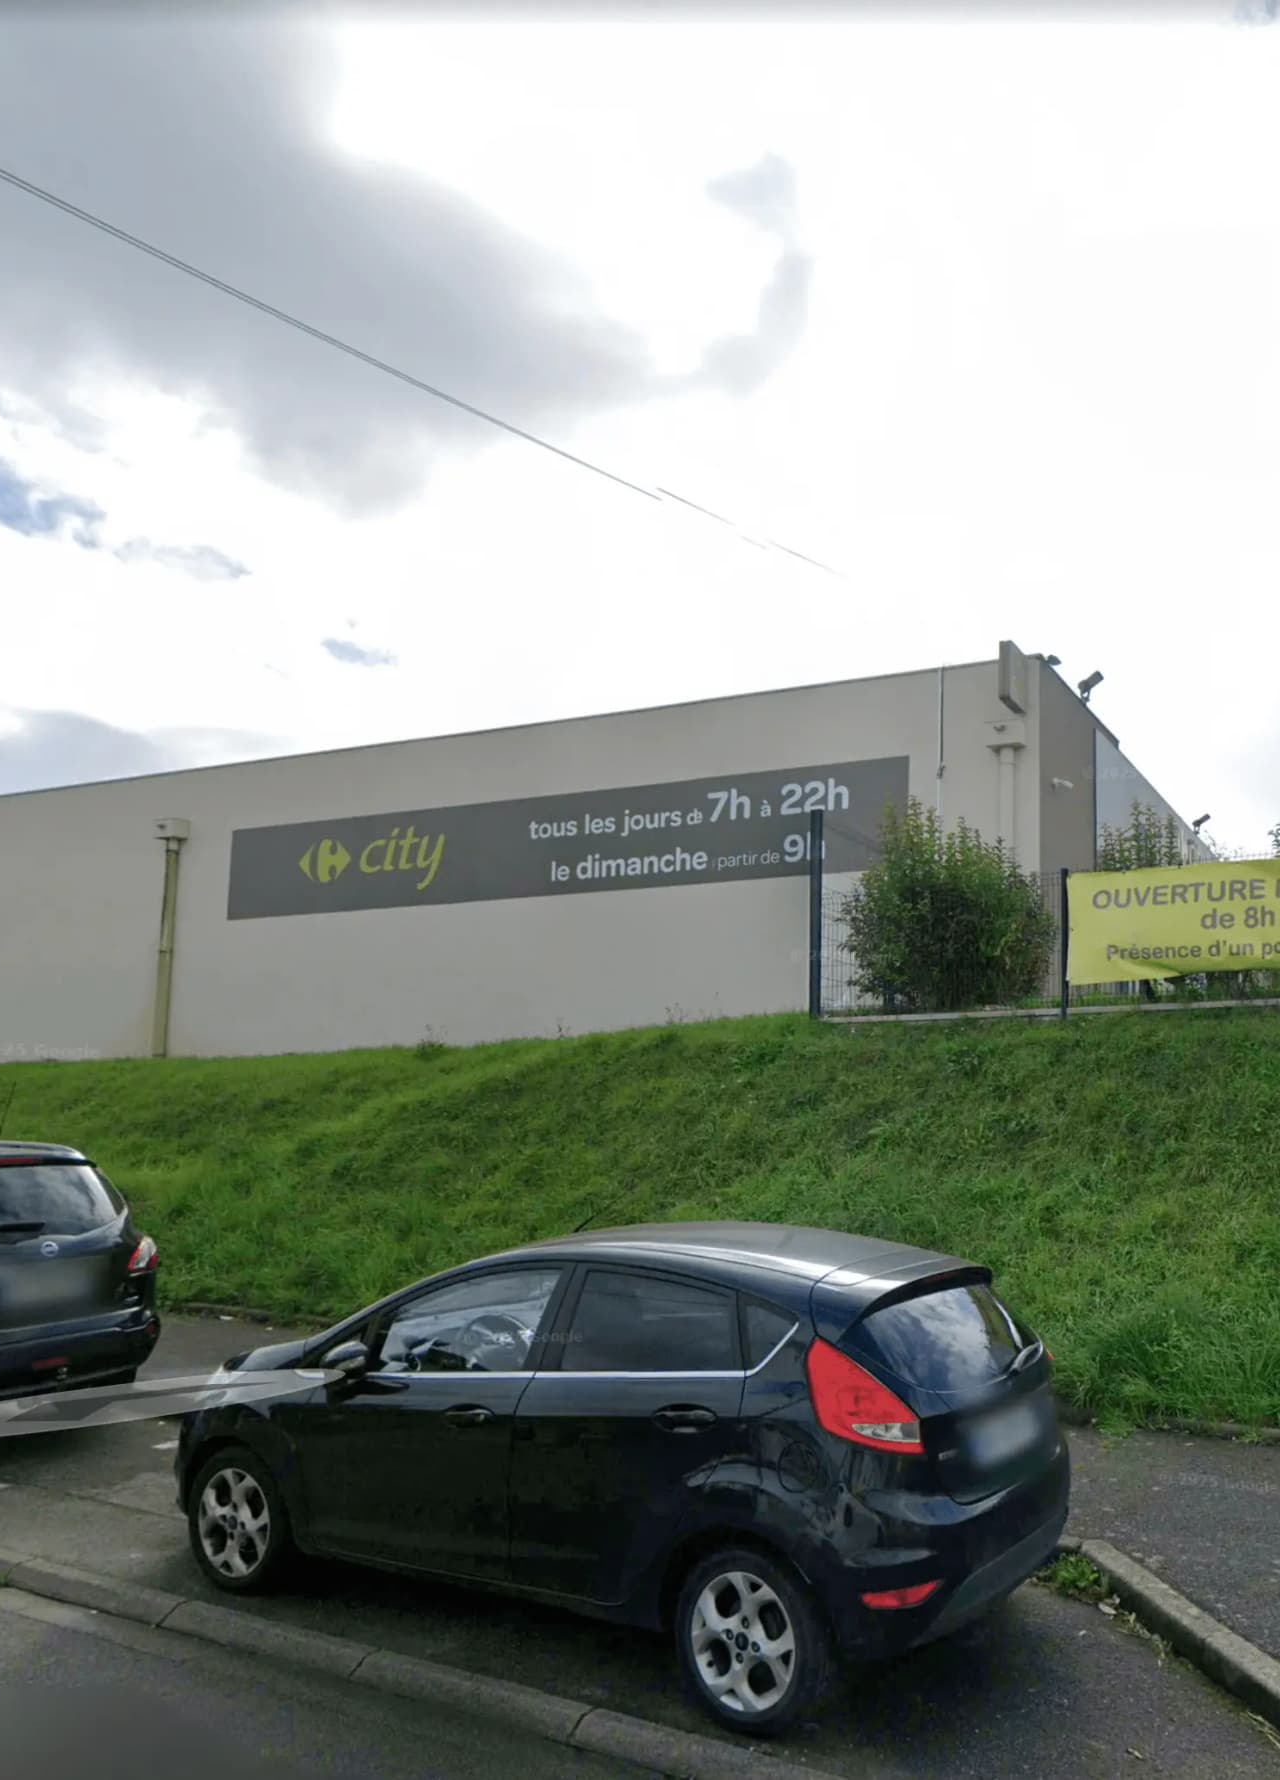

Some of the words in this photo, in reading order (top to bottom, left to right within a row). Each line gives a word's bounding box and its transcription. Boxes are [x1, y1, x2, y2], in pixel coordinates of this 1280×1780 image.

[529, 821, 577, 839] tous
[585, 814, 616, 834] les
[620, 809, 682, 837] jours
[708, 788, 751, 822] 7h
[760, 800, 771, 817] à
[780, 778, 849, 815] 22h
[359, 826, 445, 890] city
[551, 861, 570, 882] le
[576, 847, 708, 880] dimanche
[717, 852, 758, 870] partir
[761, 850, 780, 865] de
[1092, 879, 1265, 909] OUVERTURE
[1201, 908, 1235, 929] de
[1244, 906, 1275, 928] 8h
[1106, 942, 1202, 961] Présence
[1208, 940, 1254, 957] d'un
